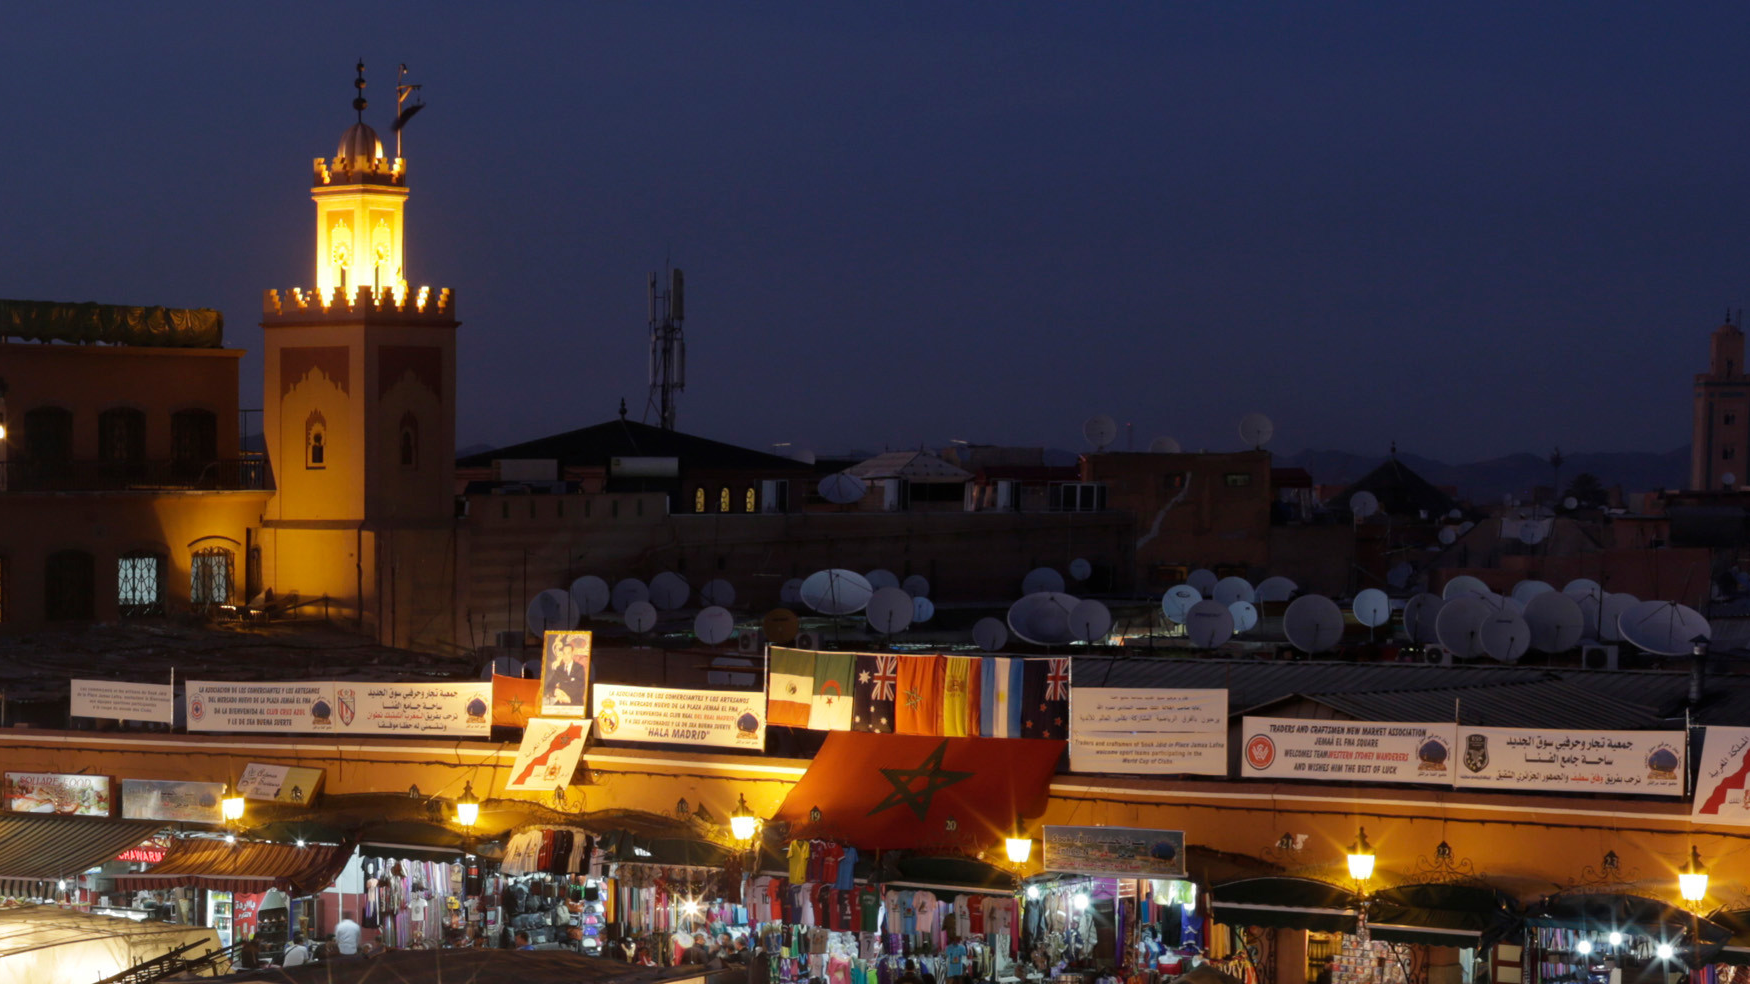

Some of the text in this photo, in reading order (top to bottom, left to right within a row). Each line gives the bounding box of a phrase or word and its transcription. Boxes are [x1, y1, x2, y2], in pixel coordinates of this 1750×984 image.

[1270, 725, 1426, 736] TRADERS AND CRAFTSMEN NEW MARKET ASSOCIATION
[1336, 738, 1342, 746] EL
[1344, 738, 1355, 746] FNA
[1357, 738, 1378, 747] SQUARE
[1507, 736, 1633, 750] جمعية تجار وحرفيي سوق الجديد
[1285, 749, 1312, 758] WELCOMES
[1354, 751, 1374, 760] SYDNEY
[1376, 752, 1409, 761] WANDERERS
[1294, 763, 1306, 771] AND
[1308, 763, 1329, 772] WISHES
[1331, 764, 1343, 772] HIM
[1358, 765, 1372, 773] BEST
[1374, 765, 1381, 773] OF
[1383, 766, 1397, 774] LUCK
[20, 776, 59, 786] SQUARE
[946, 821, 957, 831] 20
